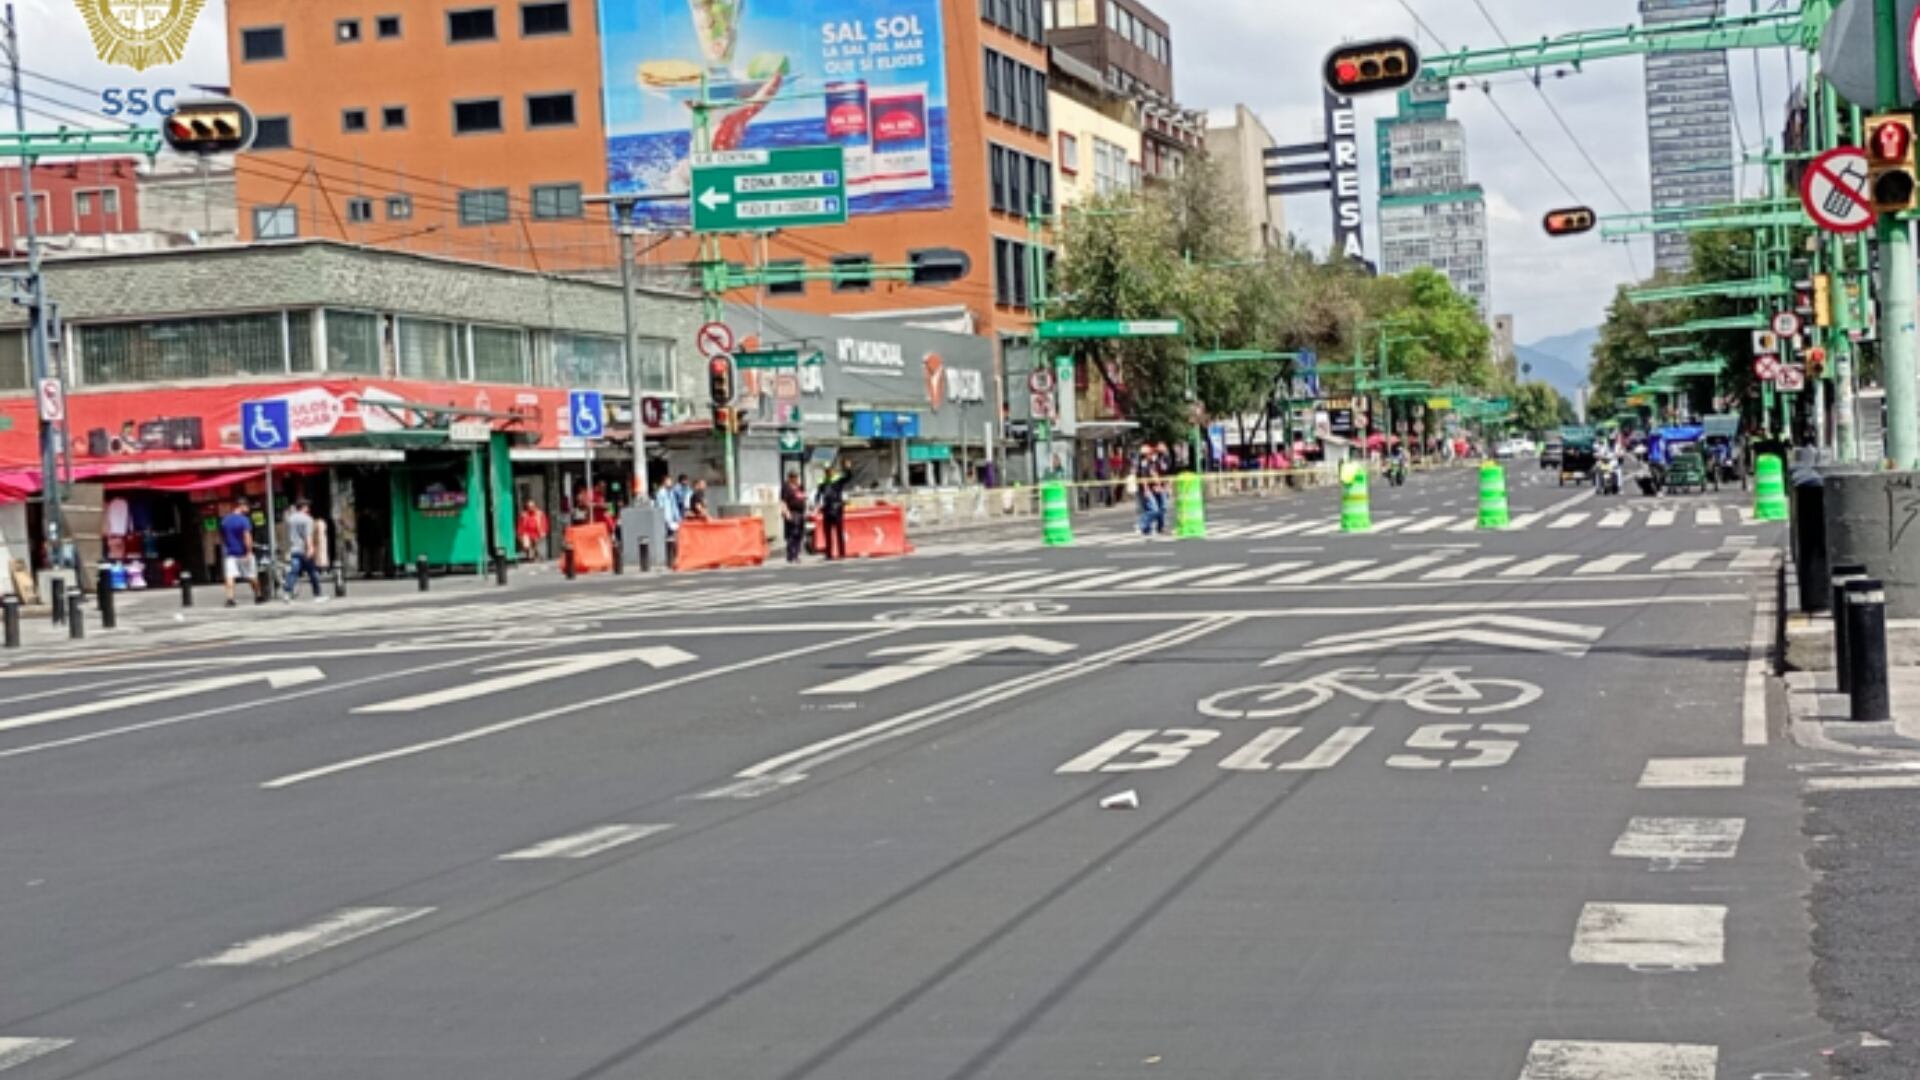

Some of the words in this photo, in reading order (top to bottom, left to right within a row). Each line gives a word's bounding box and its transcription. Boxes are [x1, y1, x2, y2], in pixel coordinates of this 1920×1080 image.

[821, 20, 868, 44] SAL
[874, 14, 923, 39] SOL
[823, 46, 838, 57] LA
[842, 43, 864, 55] SAL
[867, 41, 889, 54] DEL
[894, 38, 923, 49] MAR
[824, 60, 854, 74] QUE
[741, 176, 776, 190] ZONA
[781, 174, 816, 186] ROSA
[1332, 97, 1362, 258] ERESA
[1055, 723, 1531, 774] BUS
